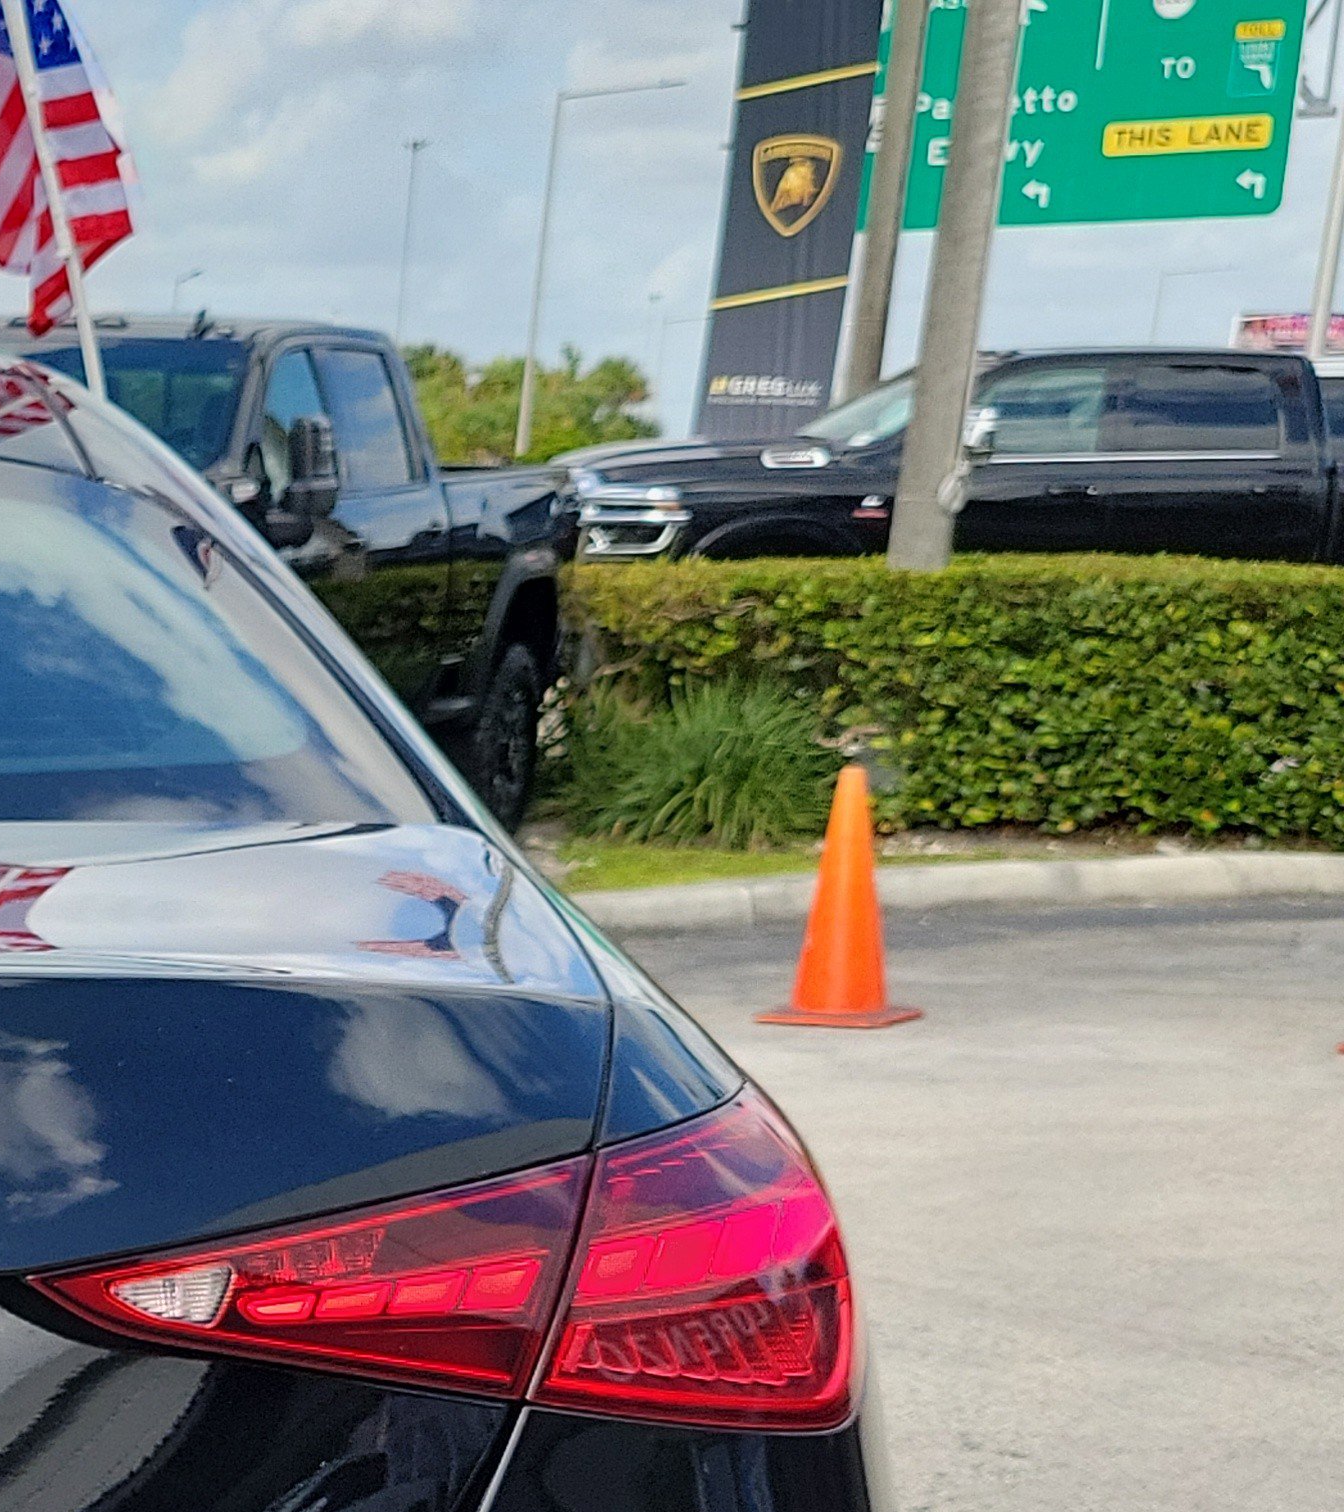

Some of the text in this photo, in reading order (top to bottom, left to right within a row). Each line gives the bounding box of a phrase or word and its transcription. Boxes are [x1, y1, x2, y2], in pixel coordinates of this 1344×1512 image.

[1161, 56, 1196, 79] TO
[1115, 120, 1263, 148] THIS LANE
